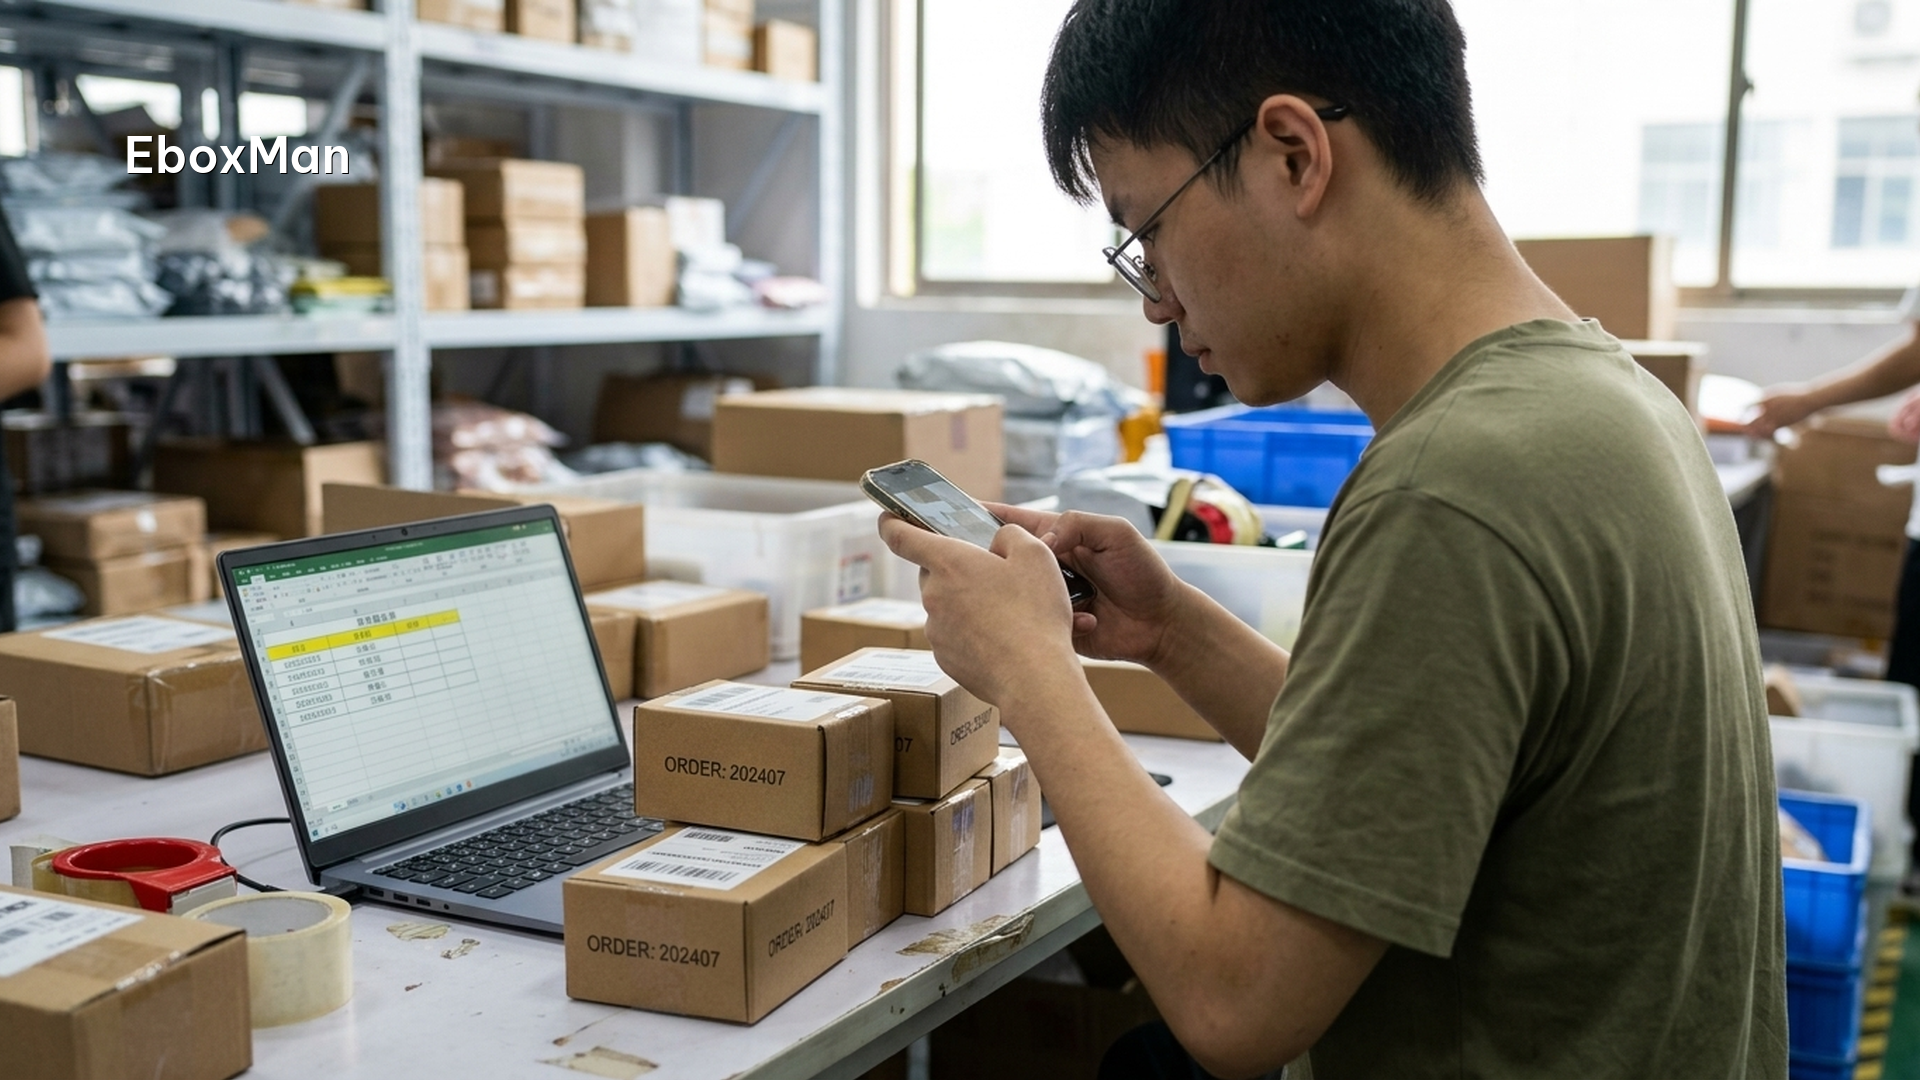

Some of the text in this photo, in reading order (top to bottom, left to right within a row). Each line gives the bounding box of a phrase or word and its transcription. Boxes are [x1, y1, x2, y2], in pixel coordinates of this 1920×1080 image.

[664, 756, 786, 786] ORDER: 202407
[587, 934, 721, 968] ORDER: 202407
